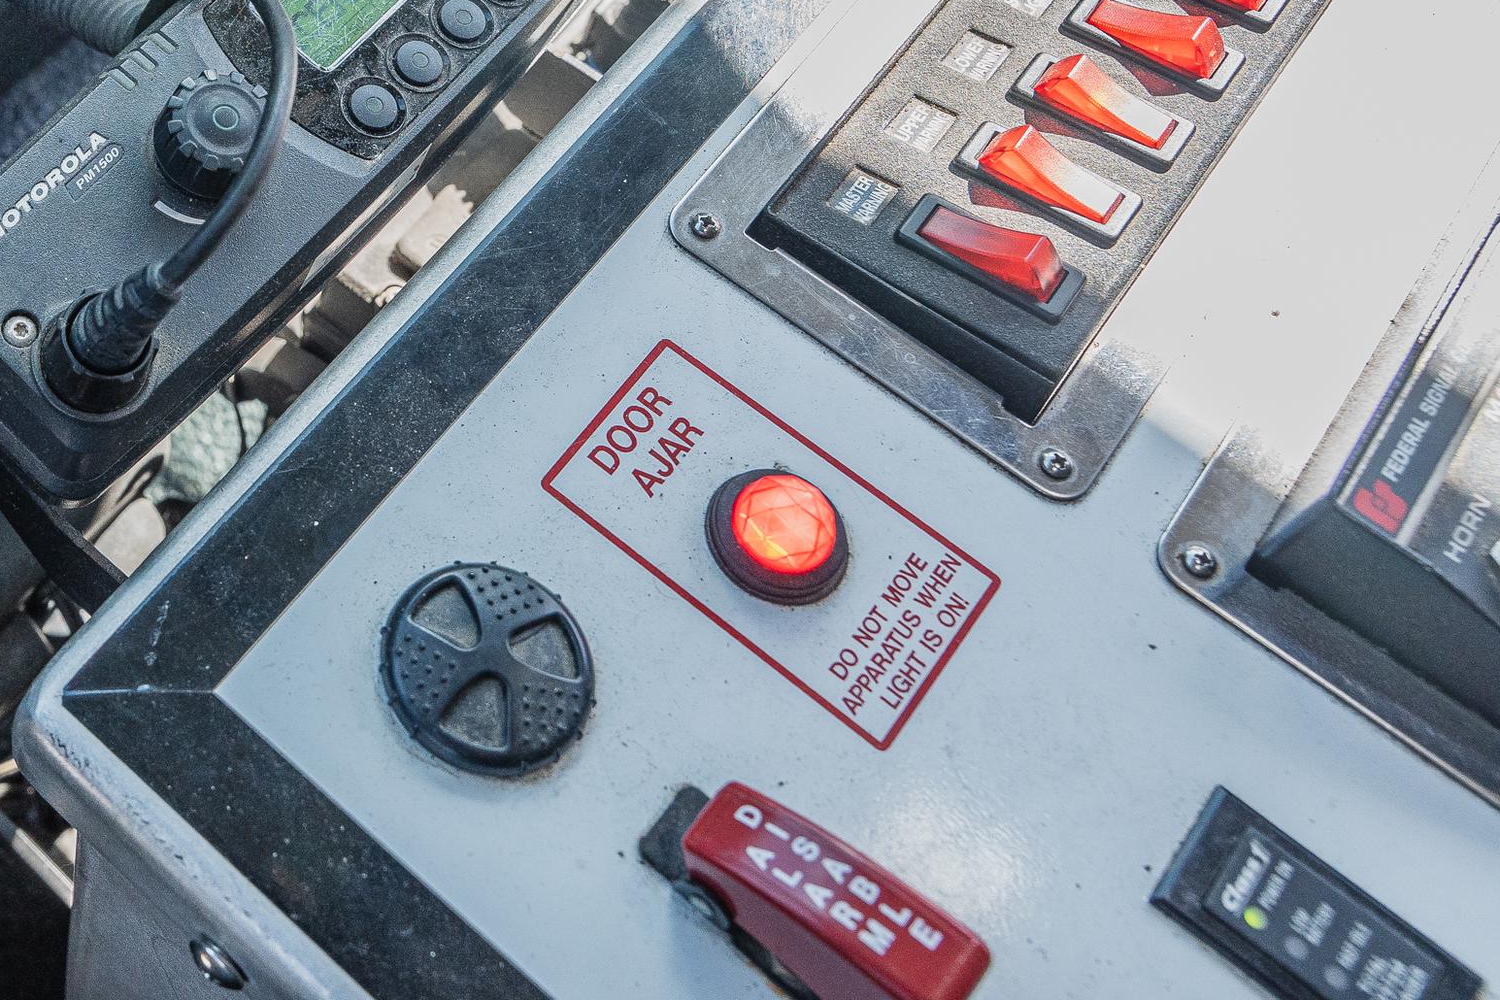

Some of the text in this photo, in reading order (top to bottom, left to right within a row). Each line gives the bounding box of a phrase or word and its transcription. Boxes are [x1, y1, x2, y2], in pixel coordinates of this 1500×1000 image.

[953, 34, 985, 72] LOWER
[969, 43, 1006, 82] WARNING
[895, 104, 929, 141] UPPER
[912, 112, 950, 152] WARNING
[75, 146, 120, 190] PM1500
[834, 175, 874, 214] MASTER
[853, 183, 892, 225] WARNING
[587, 385, 673, 476] DOOR
[631, 416, 704, 498] AJAR
[1381, 362, 1458, 482] FEDERAL SIGNAL
[1444, 494, 1493, 563] HORN
[829, 552, 929, 682] DO NOT MOVE
[841, 553, 963, 716] APPARATUS WHEN
[879, 595, 970, 711] LIGHT IS ON!
[733, 803, 944, 951] DISABLE
[745, 845, 897, 956] ALARM
